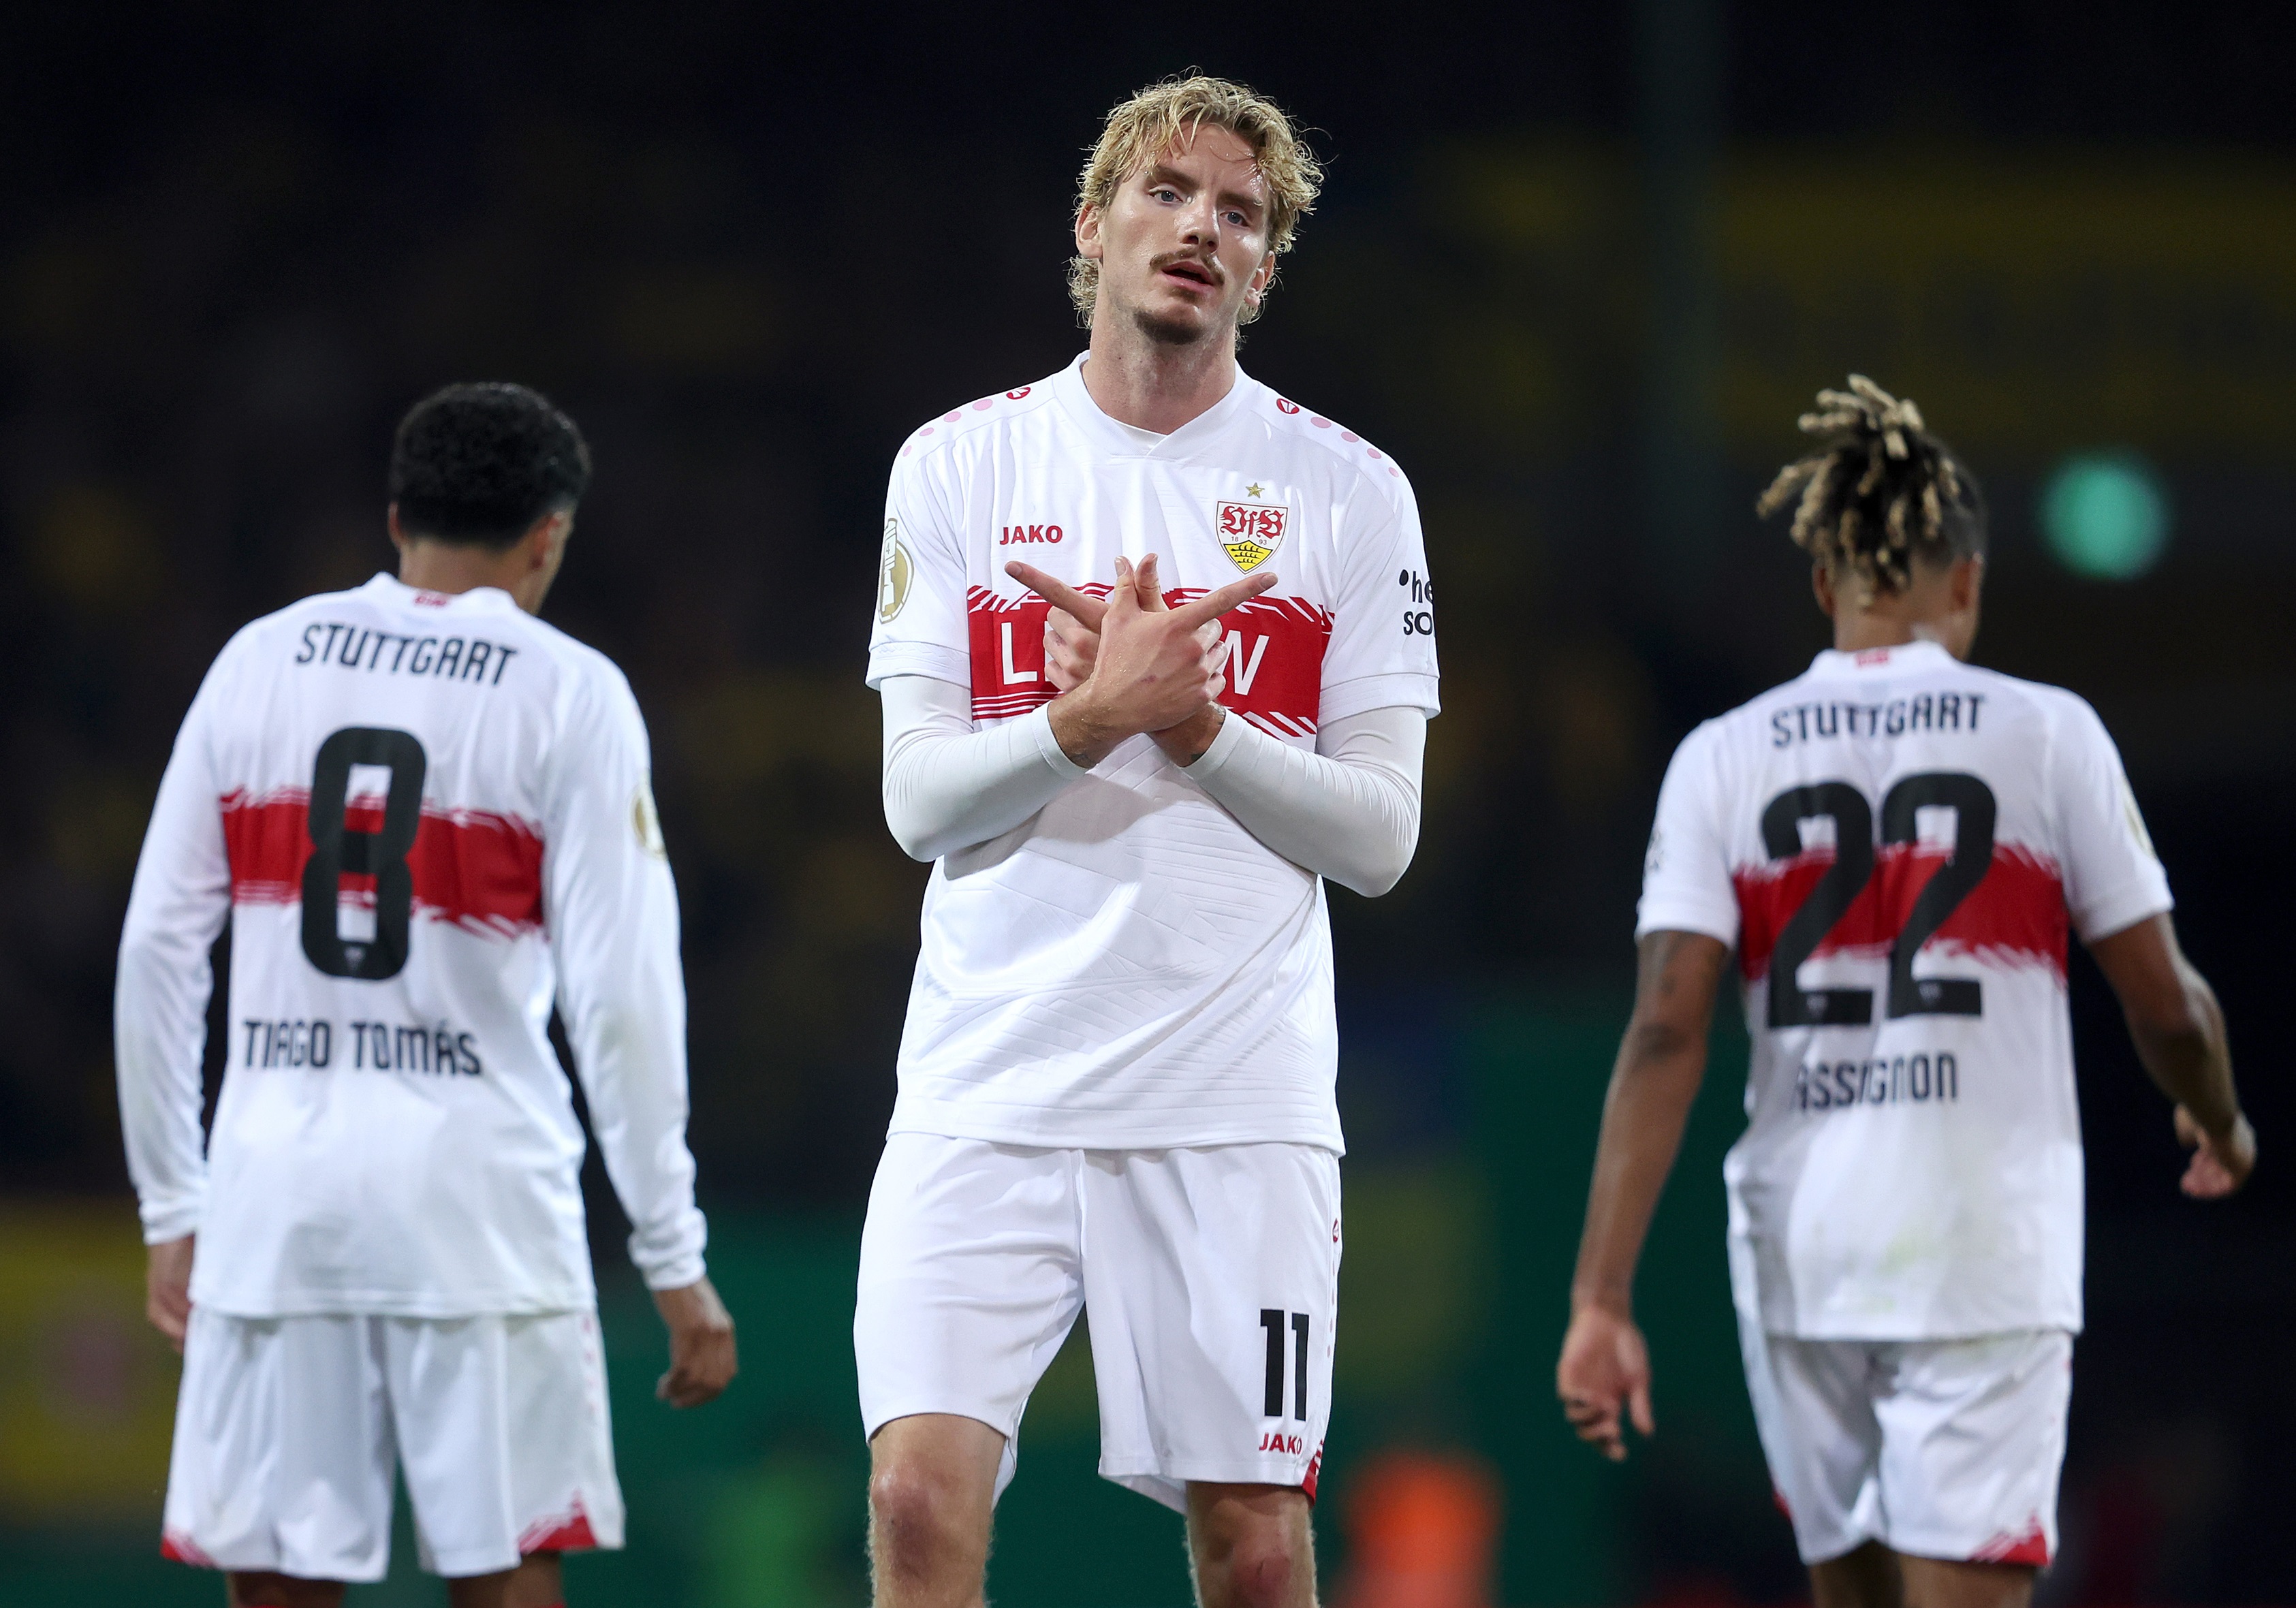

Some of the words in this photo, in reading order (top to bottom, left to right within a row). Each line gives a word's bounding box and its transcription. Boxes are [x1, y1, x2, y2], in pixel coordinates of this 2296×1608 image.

[999, 524, 1063, 545] JAKO
[1220, 506, 1284, 539] VfB
[296, 622, 518, 686] STUTTGART
[1772, 691, 1987, 748] STUTTGART
[301, 727, 426, 981] 8
[1761, 772, 1996, 1028] 22
[245, 1021, 330, 1068] TIAGO
[1260, 1308, 1309, 1421] 11
[1259, 1432, 1302, 1455] JAKO
